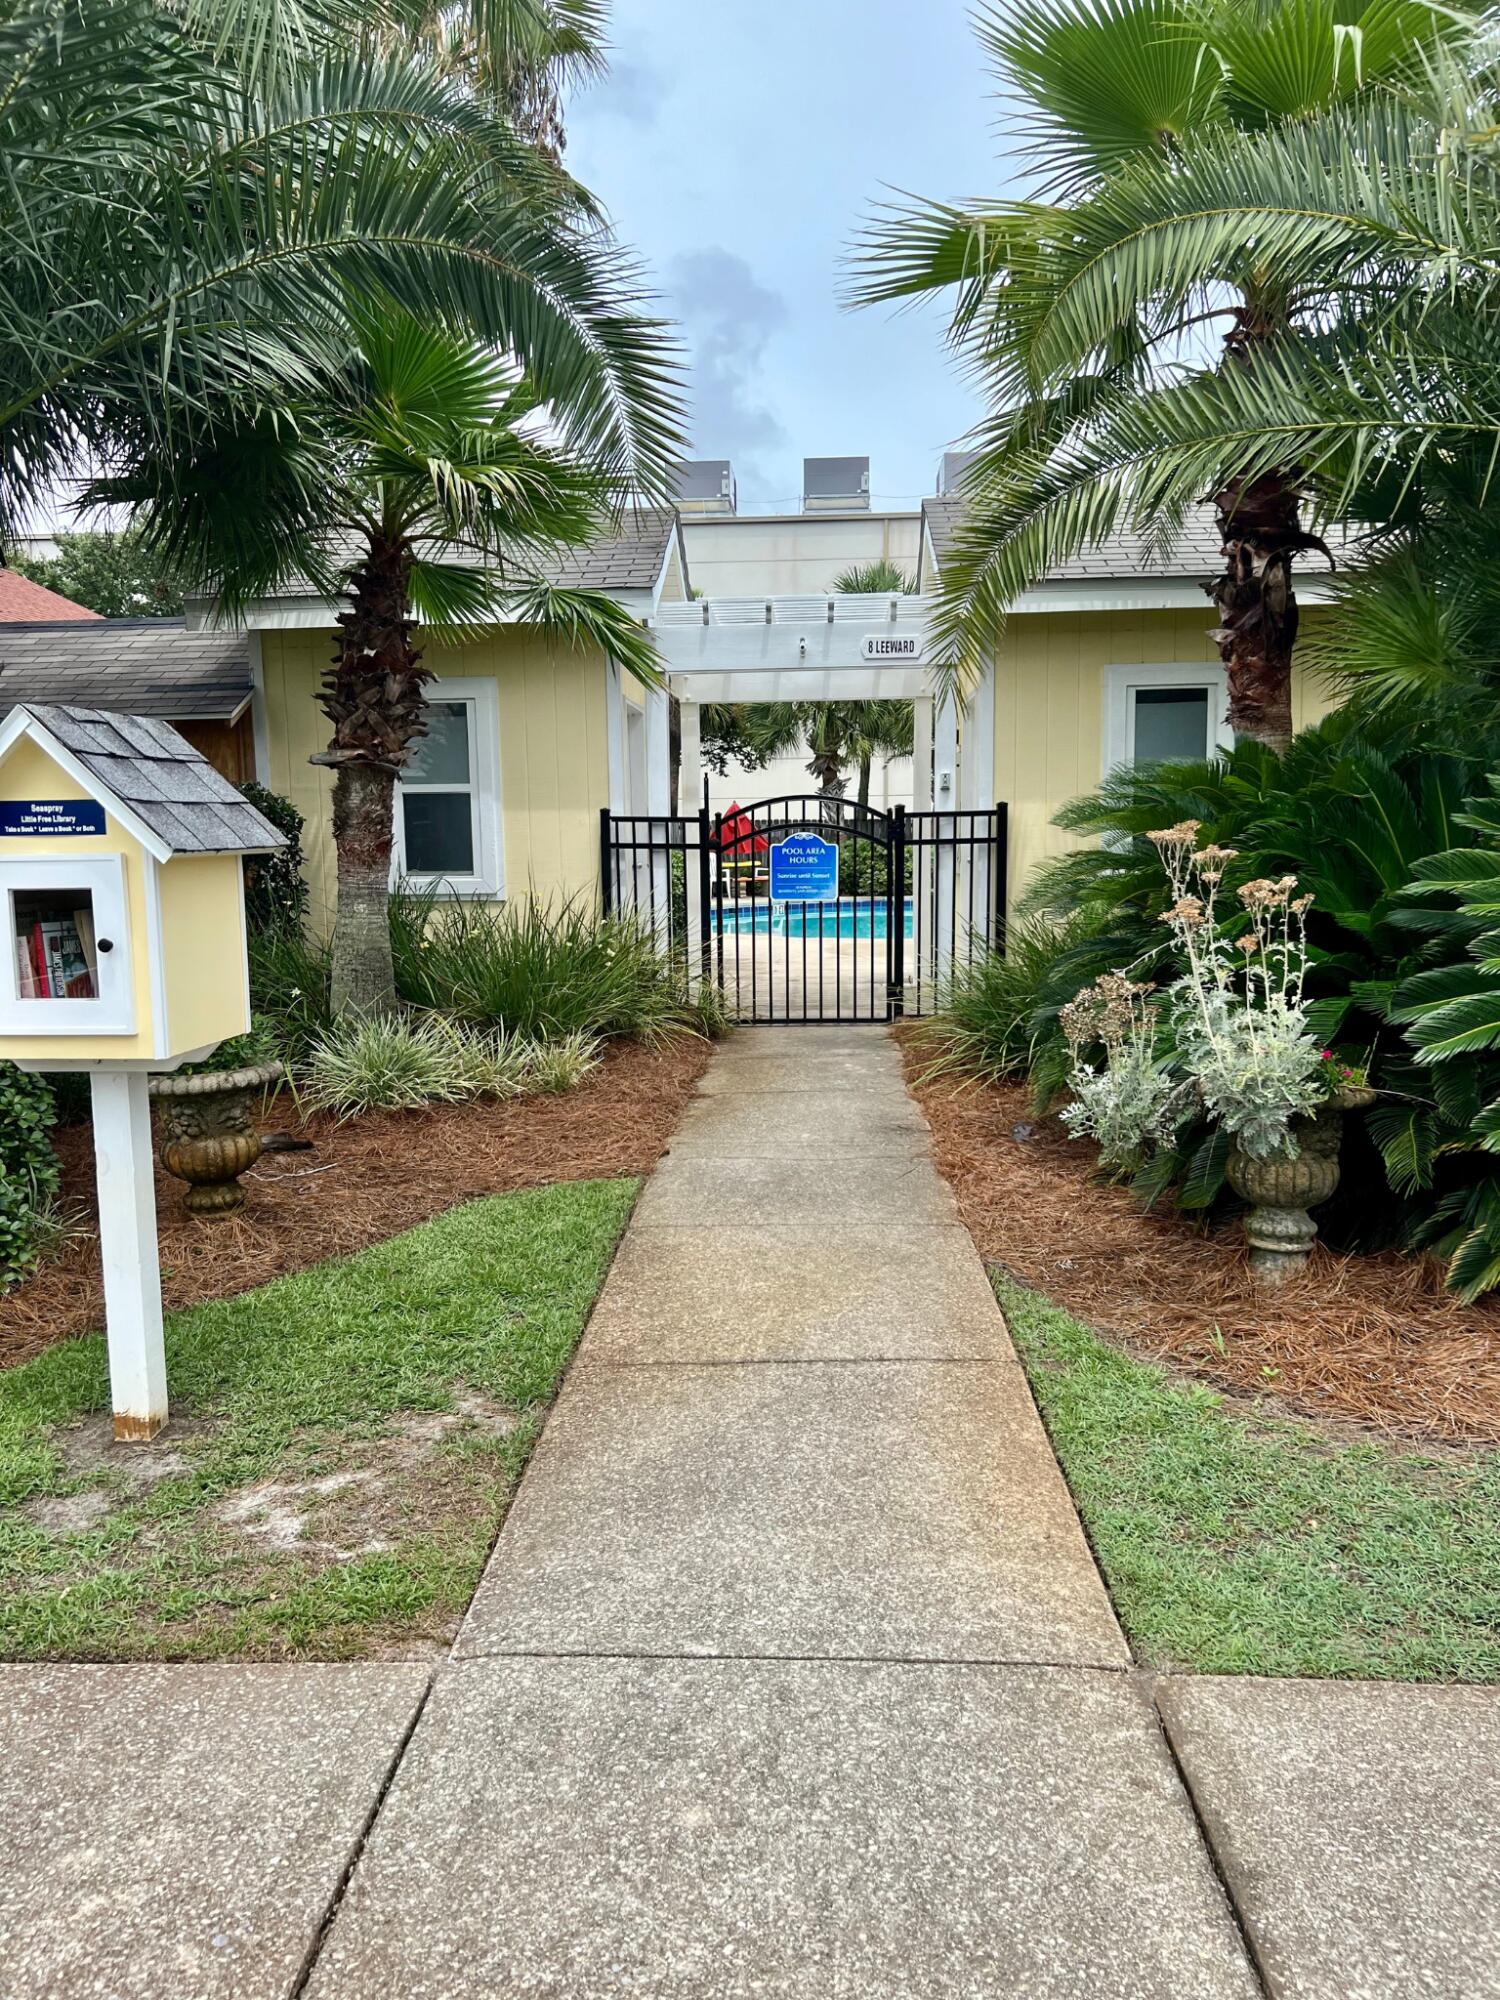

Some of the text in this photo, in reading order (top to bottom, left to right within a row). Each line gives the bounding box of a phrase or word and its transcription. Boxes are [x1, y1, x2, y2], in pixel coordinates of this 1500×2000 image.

[868, 640, 915, 653] 8 LEEWARD
[31, 804, 64, 813] Seaspray
[21, 814, 76, 823] Little Free Library
[782, 847, 804, 855] POOL
[790, 856, 818, 864] HOURS
